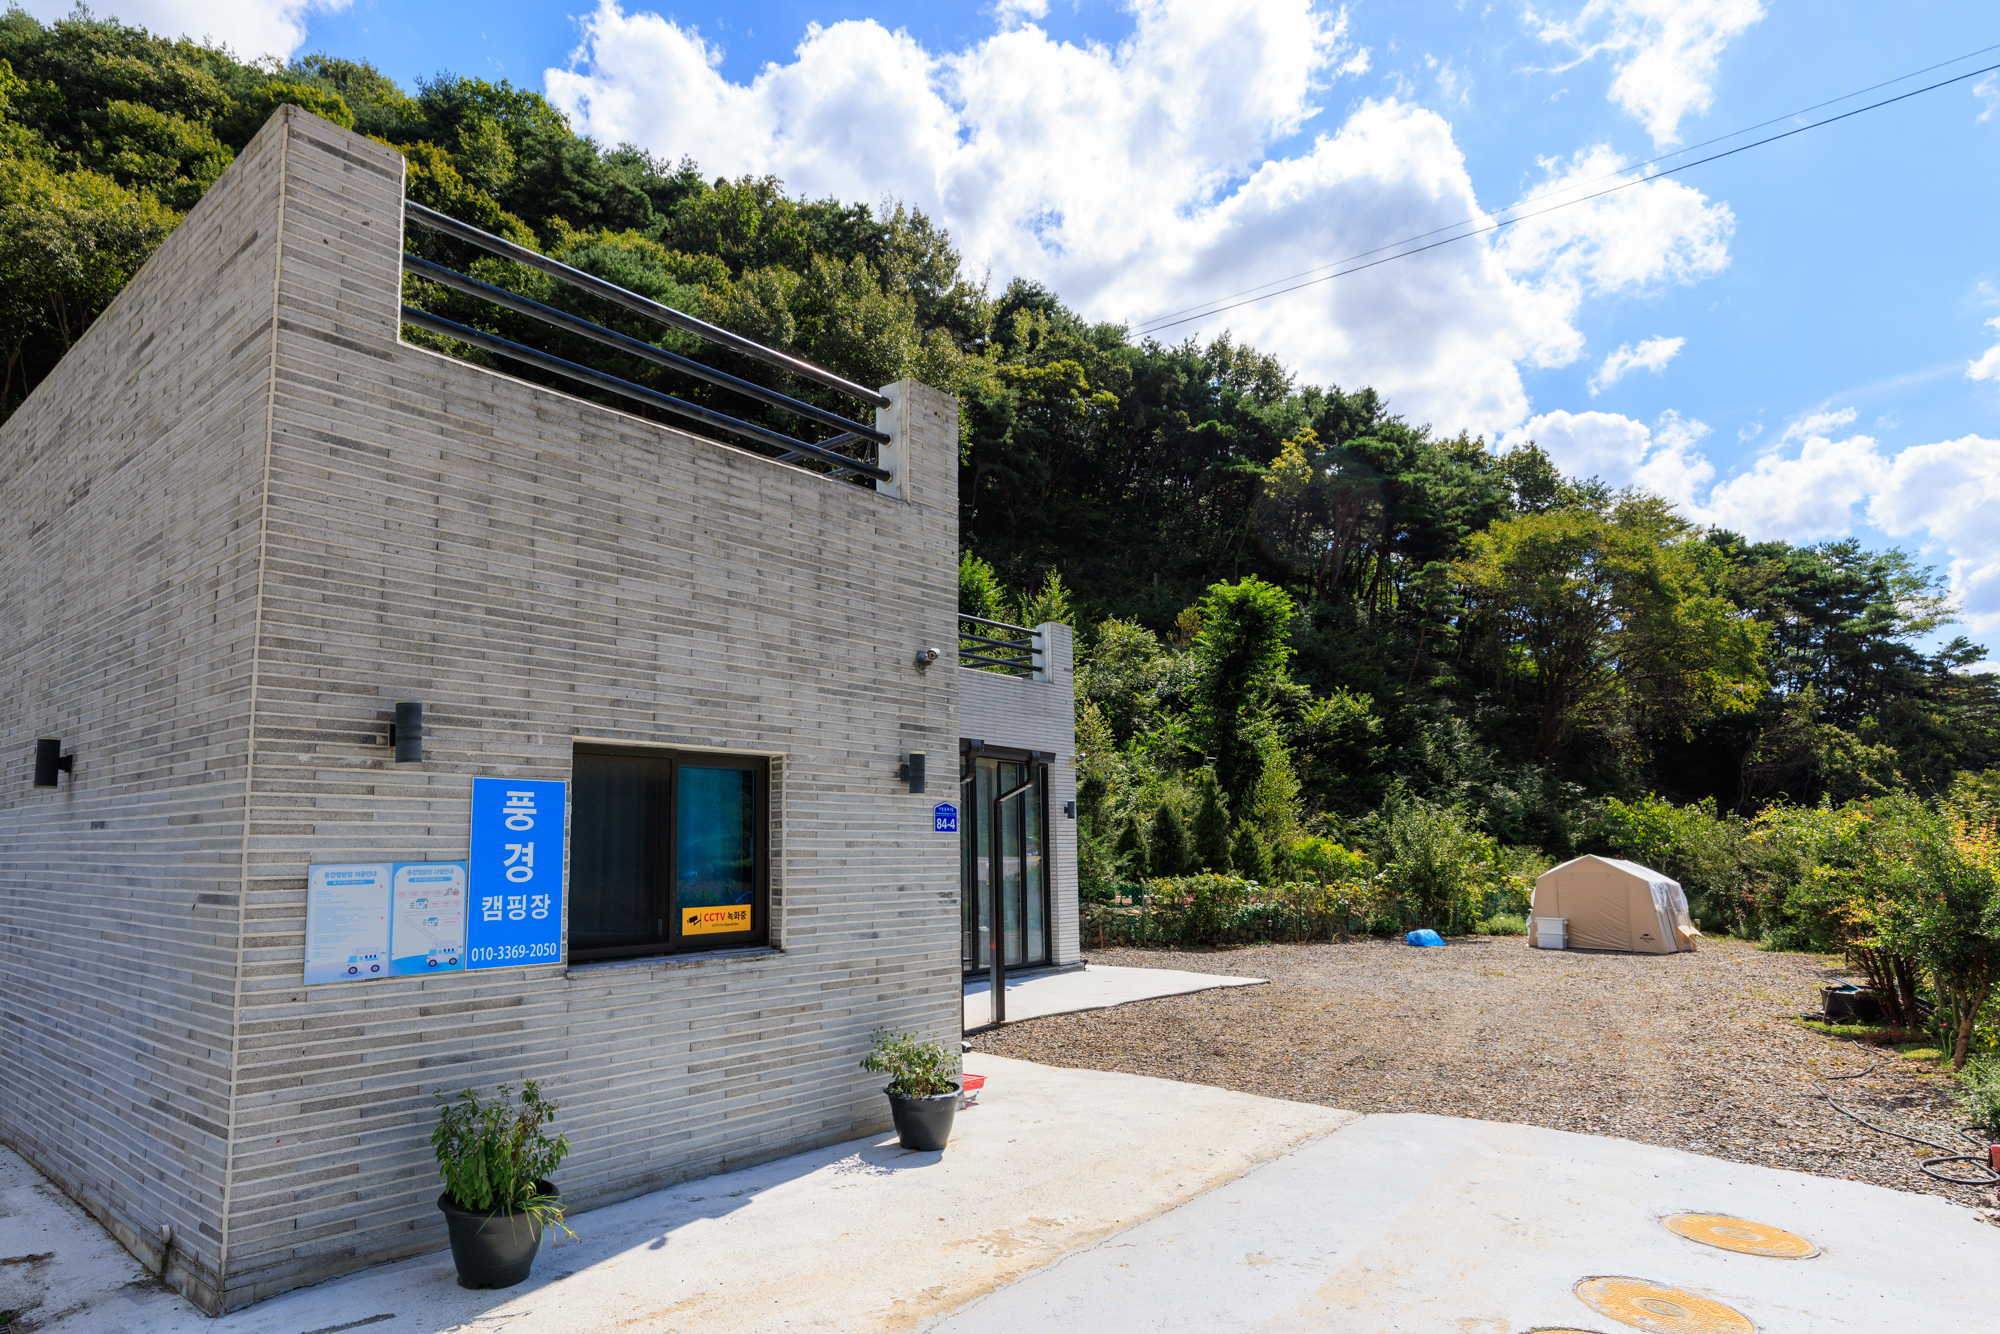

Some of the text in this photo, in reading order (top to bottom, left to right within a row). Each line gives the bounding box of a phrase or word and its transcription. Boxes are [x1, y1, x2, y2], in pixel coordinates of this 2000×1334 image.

[936, 817, 956, 830] 84-4
[481, 893, 551, 921] 캠핑장
[703, 910, 747, 922] CCTV 녹화중
[471, 942, 557, 962] 010-3369-2050
